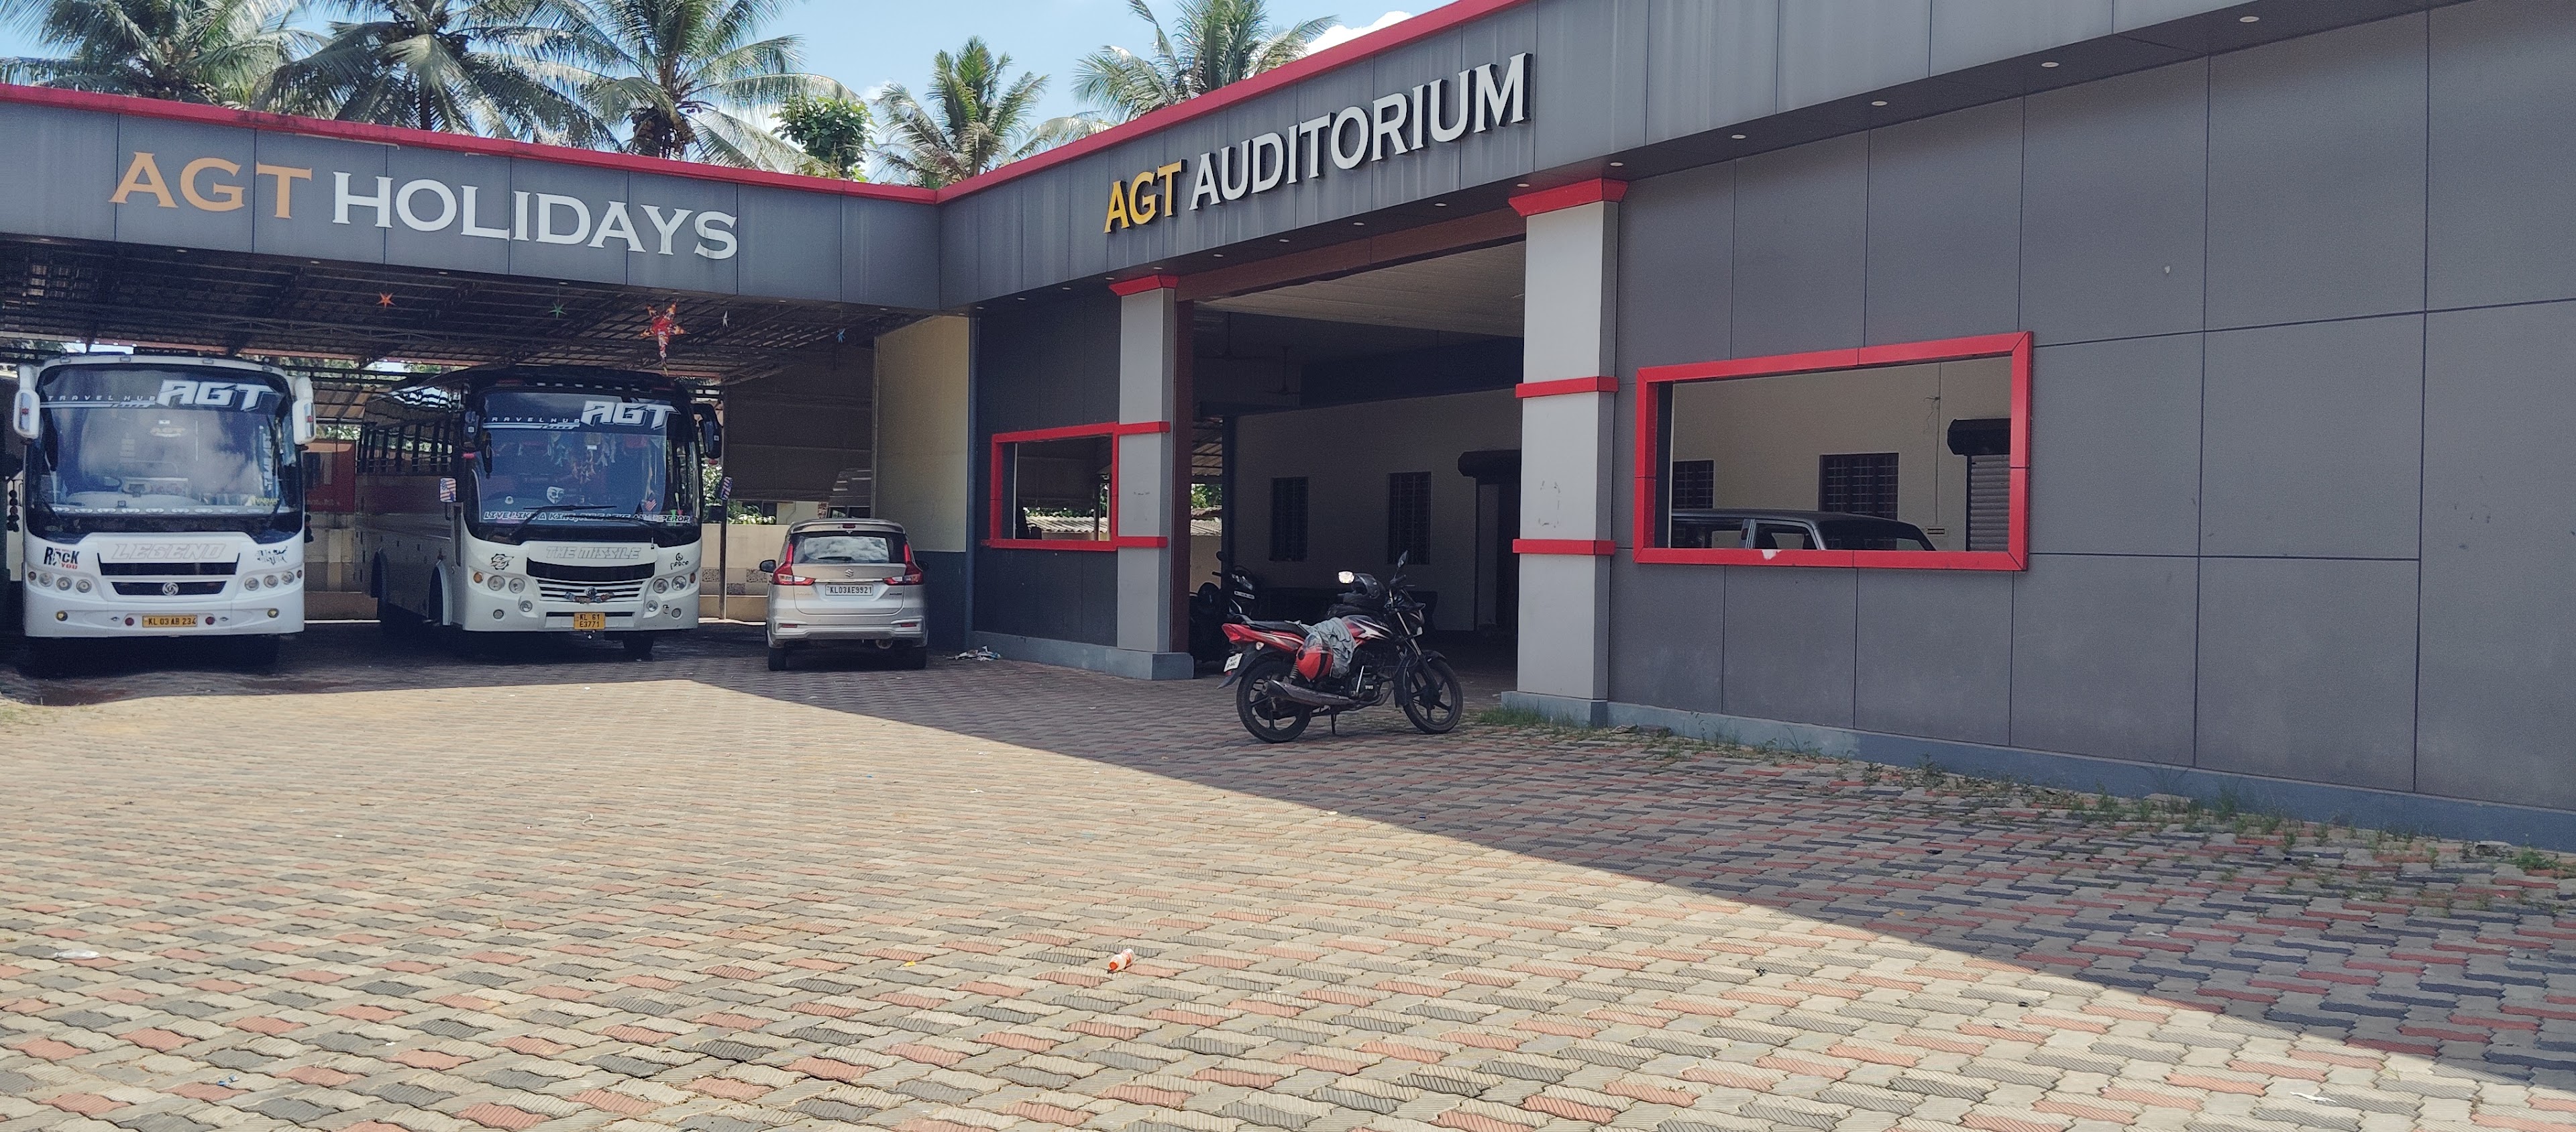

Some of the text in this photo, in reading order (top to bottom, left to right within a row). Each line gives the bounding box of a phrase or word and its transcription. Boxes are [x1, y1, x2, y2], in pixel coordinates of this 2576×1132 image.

[1104, 52, 1532, 233] AGT AUDITORIUM
[108, 151, 739, 260] AGT HOLIDAYS
[156, 379, 278, 411] AGT
[580, 401, 680, 430] AGT
[483, 511, 509, 521] LIVE
[510, 511, 537, 521] LIK
[111, 544, 227, 560] LEGEND
[546, 546, 641, 559] THE MISSILE
[830, 586, 872, 594] KL03AE9921
[148, 617, 158, 625] KL
[160, 617, 169, 625] 03
